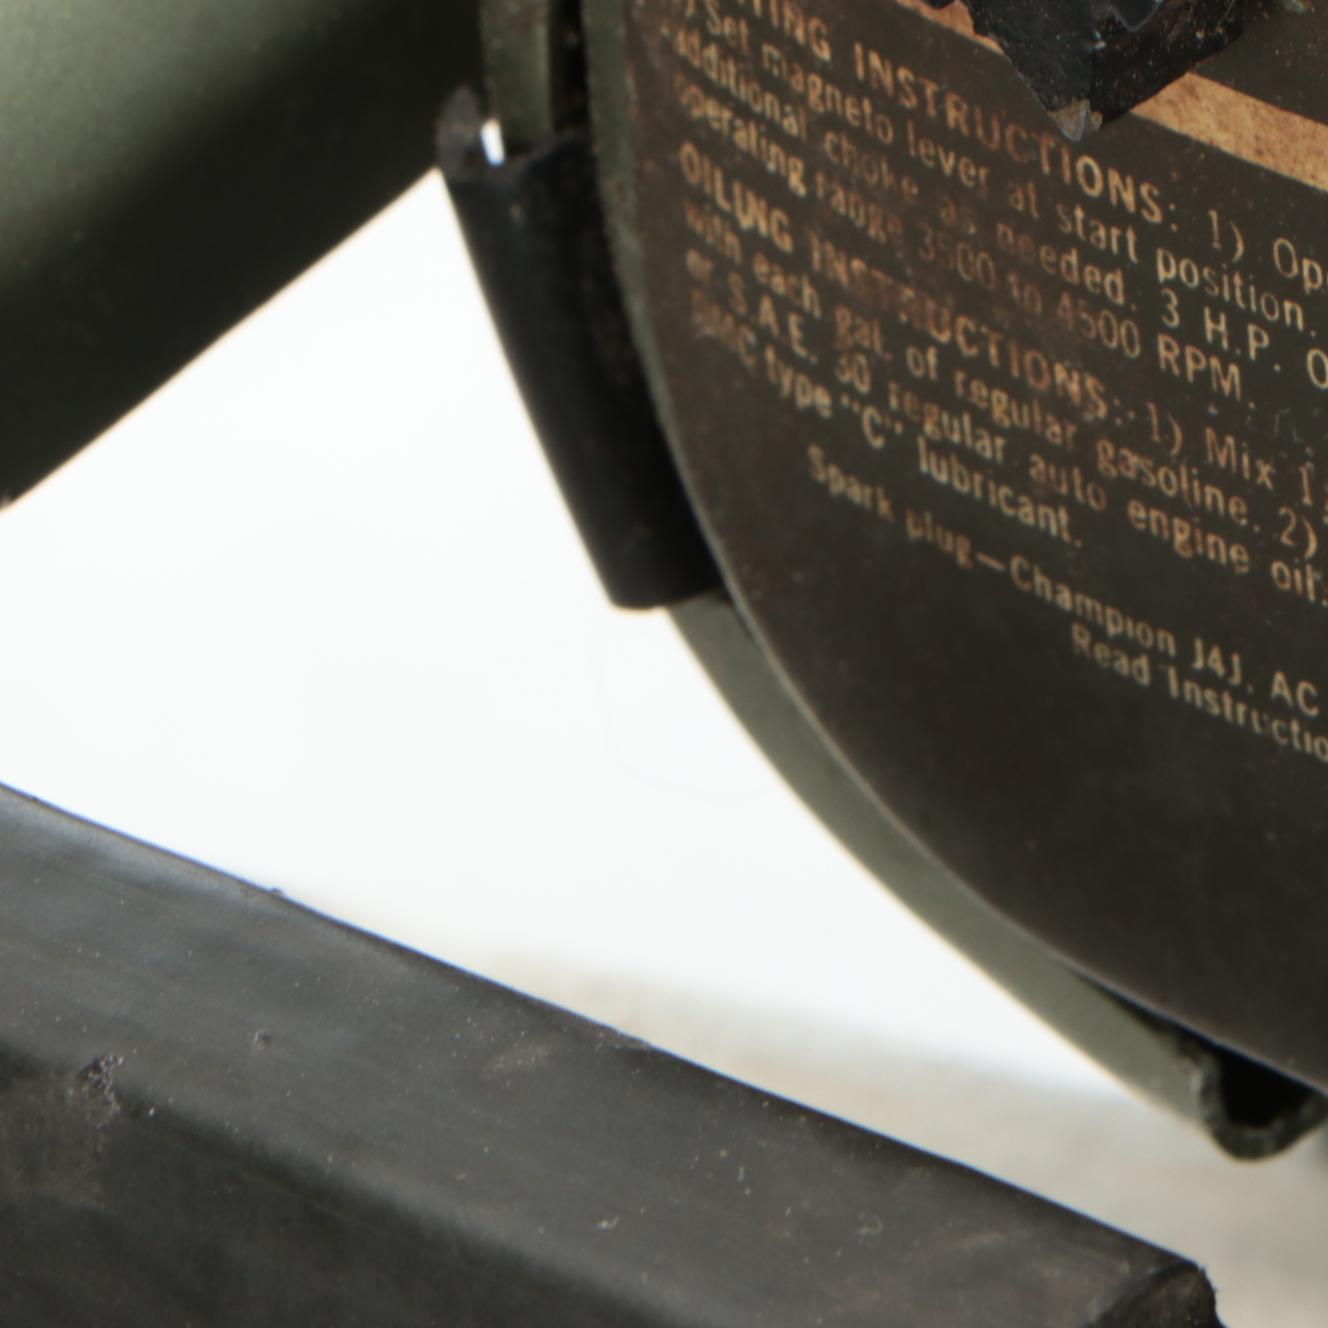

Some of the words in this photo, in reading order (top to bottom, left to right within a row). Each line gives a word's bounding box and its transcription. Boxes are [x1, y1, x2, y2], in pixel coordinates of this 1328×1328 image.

[762, 41, 894, 145] magneto
[906, 119, 990, 192] lever
[1007, 180, 1040, 220] at
[1055, 202, 1139, 264] start
[1156, 247, 1317, 338] position.
[853, 41, 1178, 232] INSTRUCTIONS:
[1208, 209, 1244, 262] 1)
[678, 140, 793, 255] OILING
[1147, 401, 1183, 456] 1)
[1204, 425, 1274, 491] Mix
[1007, 270, 1043, 315] to
[1156, 332, 1256, 409] RPM.
[1160, 287, 1182, 328] 3
[888, 380, 1007, 463] regular
[1029, 452, 1107, 513] auto
[1126, 498, 1250, 573] engine
[906, 345, 938, 382] of
[954, 368, 1077, 452] regular
[1096, 437, 1261, 534] gasoline.
[1277, 506, 1318, 559] 2)
[916, 434, 1084, 549] lubricant.
[807, 443, 896, 523] Spark
[1269, 670, 1320, 718] AC
[1070, 621, 1151, 688] Read
